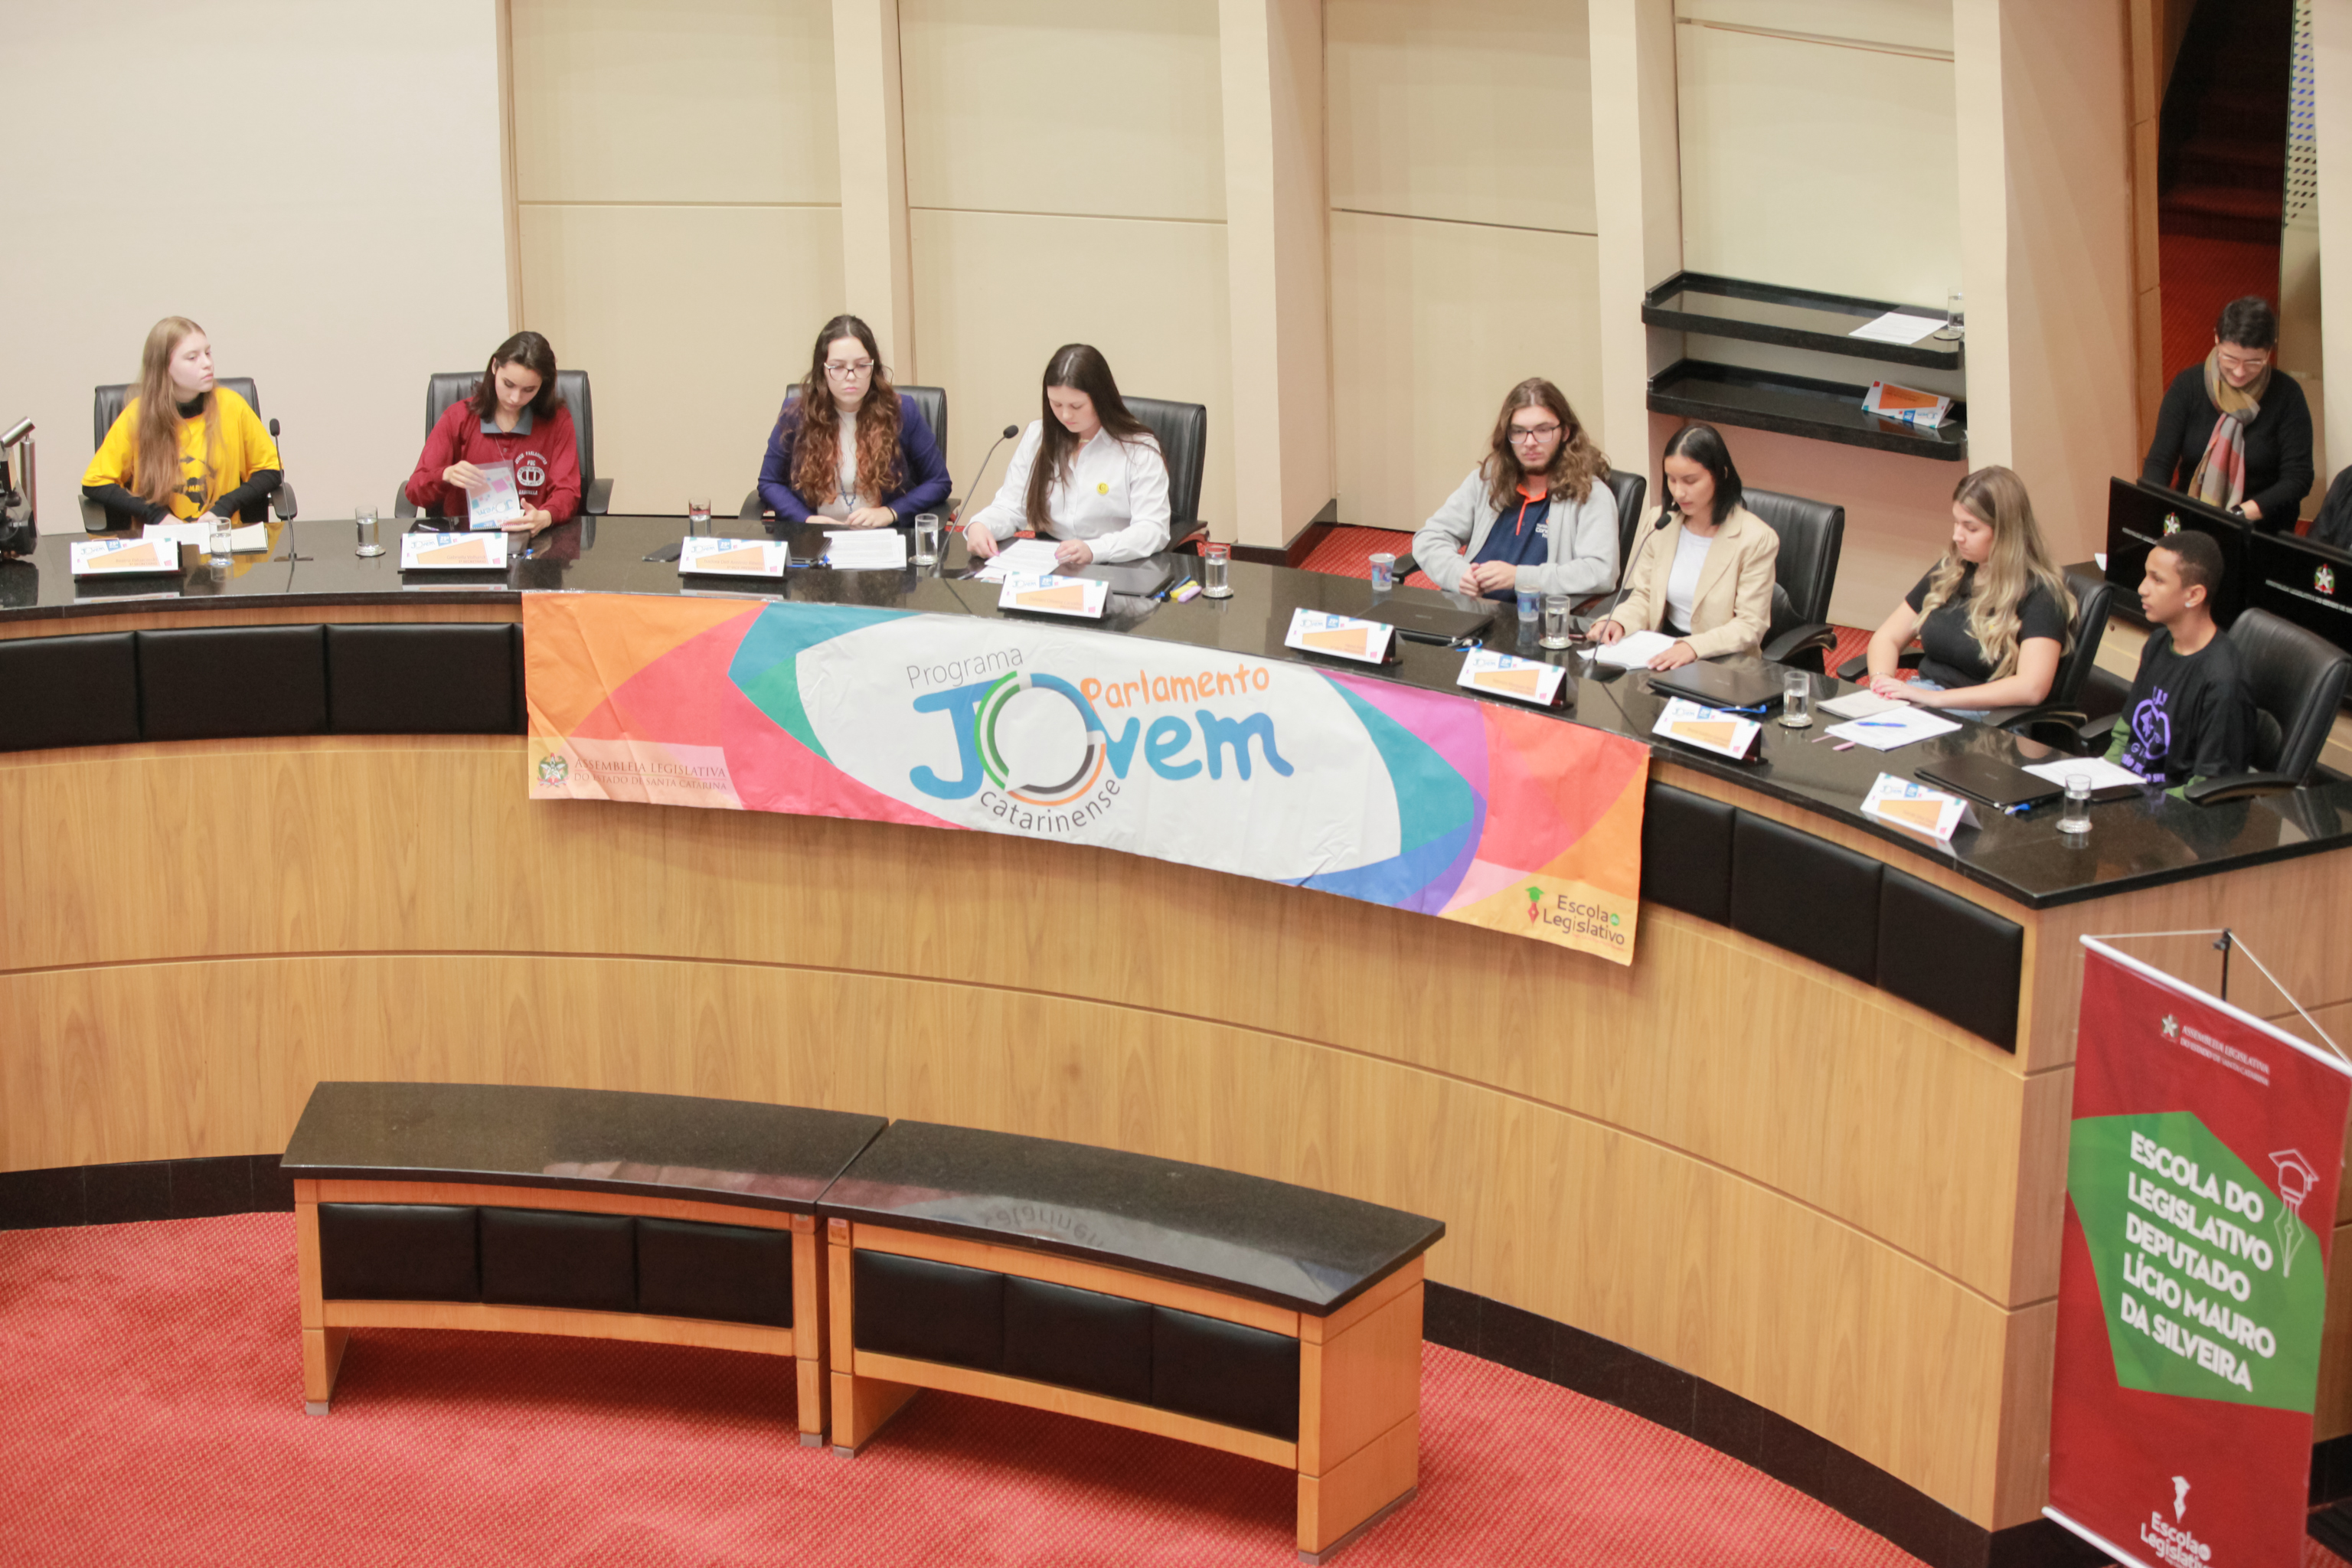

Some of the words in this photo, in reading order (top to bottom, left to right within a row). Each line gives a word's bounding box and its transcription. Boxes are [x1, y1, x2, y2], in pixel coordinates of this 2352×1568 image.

[906, 648, 1023, 689] Programa
[1080, 663, 1269, 719] Parlamento
[574, 773, 590, 781] DO
[646, 778, 676, 787] SANTA
[679, 779, 727, 790] CATARINA
[575, 758, 645, 773] ASSEMBLEIA
[651, 763, 726, 777] LEGISLATIVA
[1544, 908, 1625, 945] Legislativo
[1557, 894, 1609, 923] Escola
[2131, 1131, 2221, 1205] ESCOLA
[2224, 1180, 2264, 1223] DO
[2128, 1171, 2273, 1271] LEGISLATIVO
[2125, 1211, 2251, 1302] DEPUTADO
[2120, 1292, 2150, 1336] DA
[2152, 1313, 2253, 1392] SILVEIRA
[2184, 1289, 2276, 1358] MAURO
[2140, 1522, 2210, 1568] Legislativ
[2151, 1511, 2199, 1555] Escola
